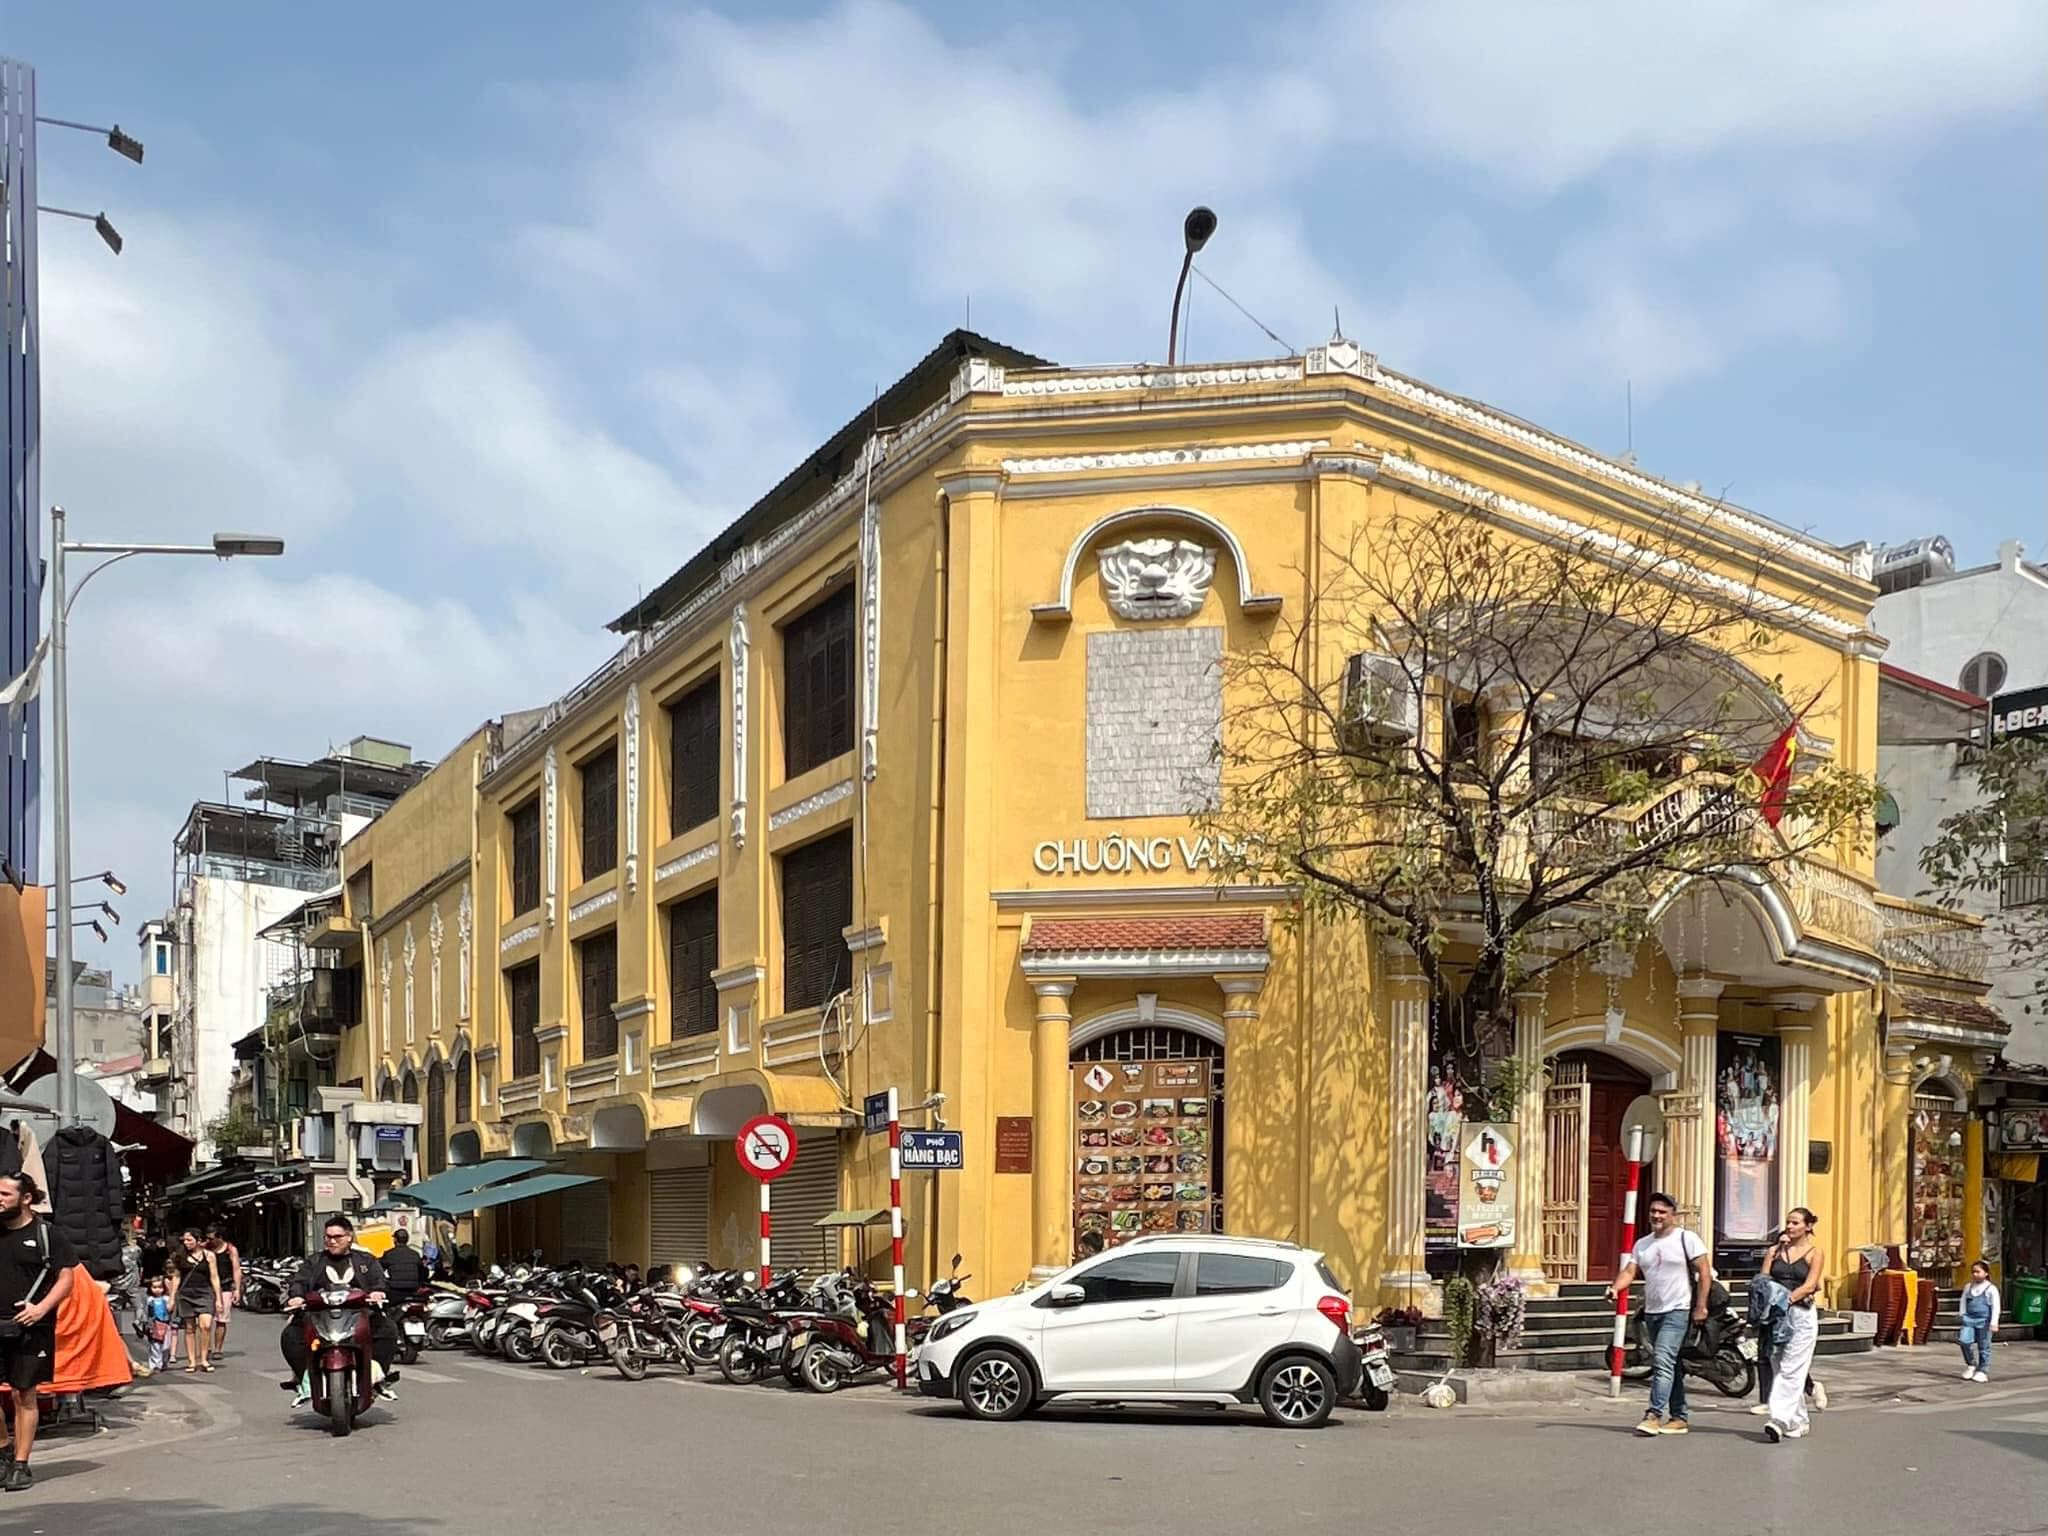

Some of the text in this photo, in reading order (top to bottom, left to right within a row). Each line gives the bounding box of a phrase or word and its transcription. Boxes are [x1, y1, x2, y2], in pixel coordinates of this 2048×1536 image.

[1033, 831, 1172, 873] CHUÔNG
[926, 1136, 946, 1146] PHỐ
[904, 1146, 959, 1166] HÀNG BẠC
